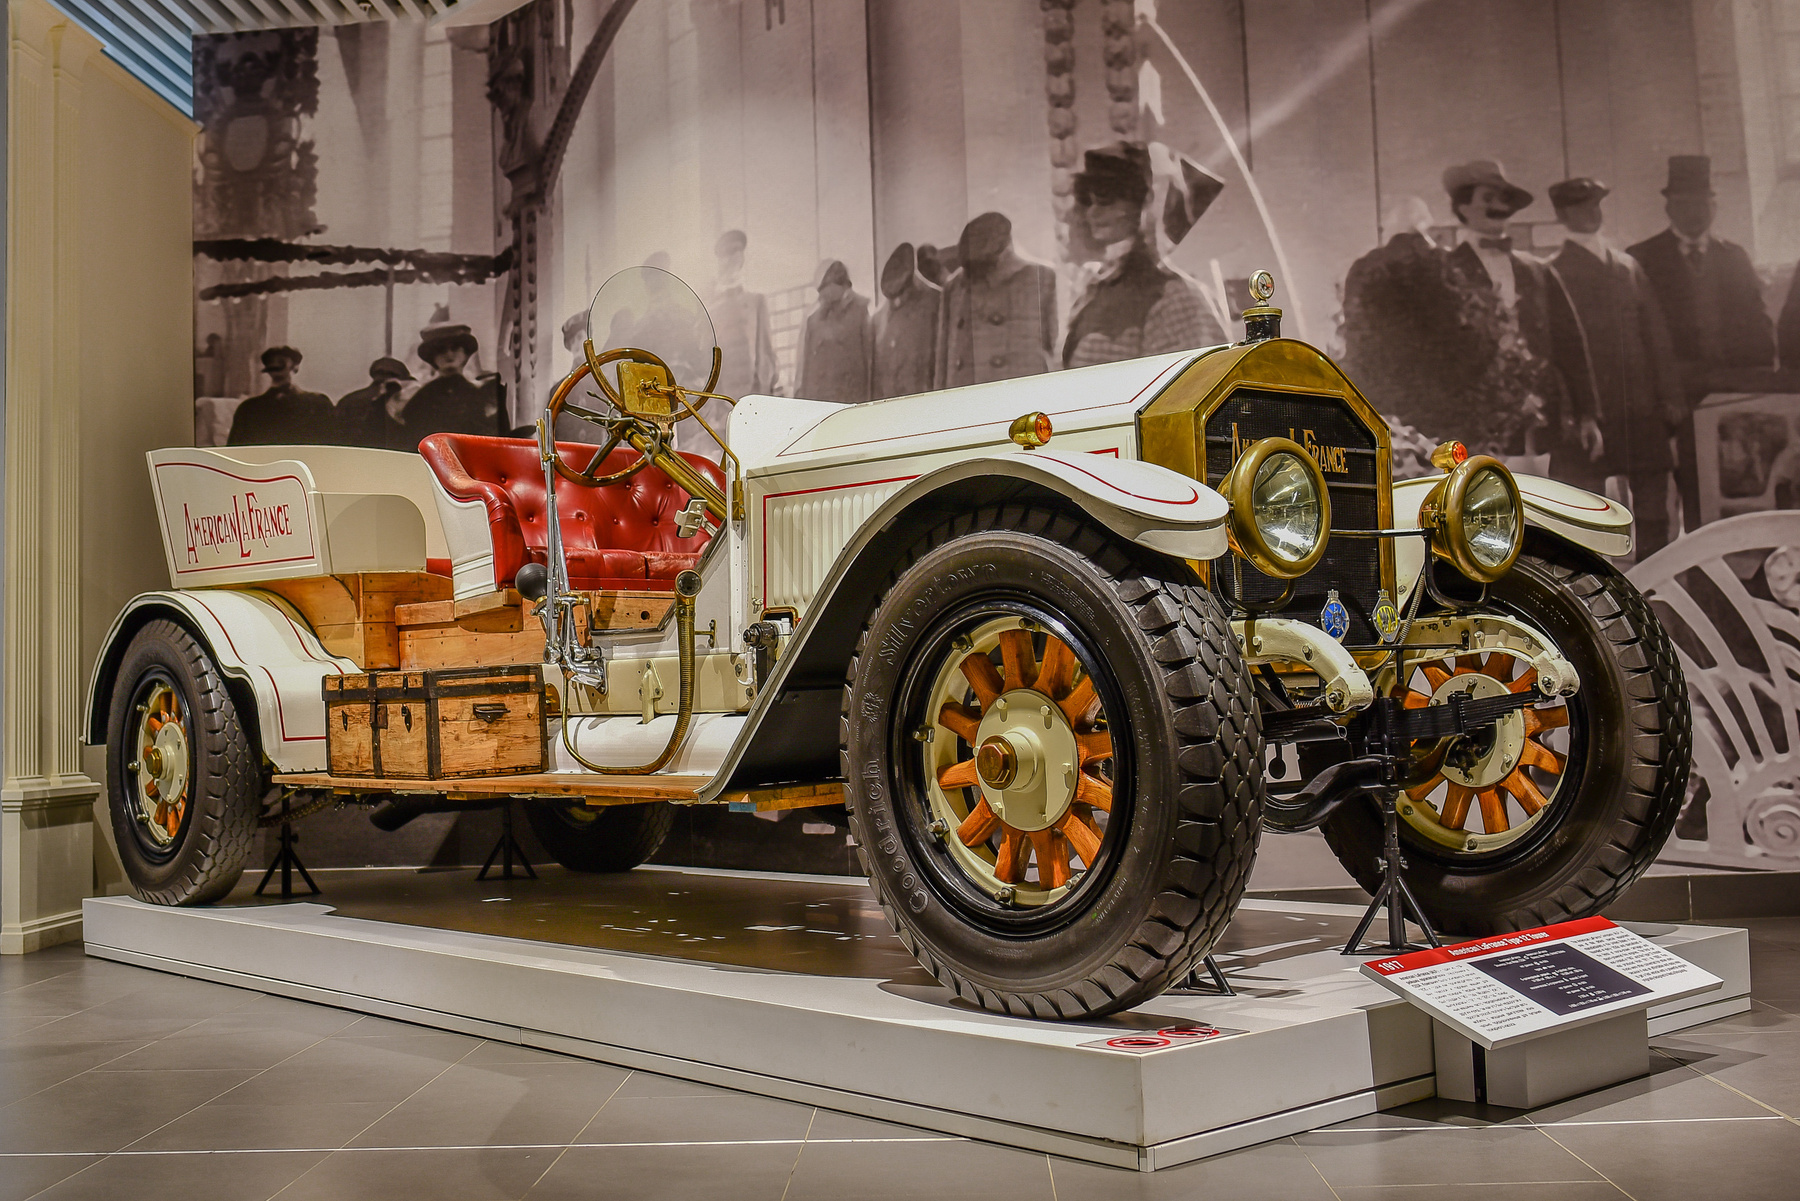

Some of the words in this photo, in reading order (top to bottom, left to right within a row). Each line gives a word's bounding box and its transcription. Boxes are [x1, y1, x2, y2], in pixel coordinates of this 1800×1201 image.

[862, 758, 930, 915] Goodrich
[1447, 946, 1481, 957] American
[1502, 937, 1523, 946] Type
[1518, 934, 1532, 942] 12
[1377, 959, 1405, 973] 1917
